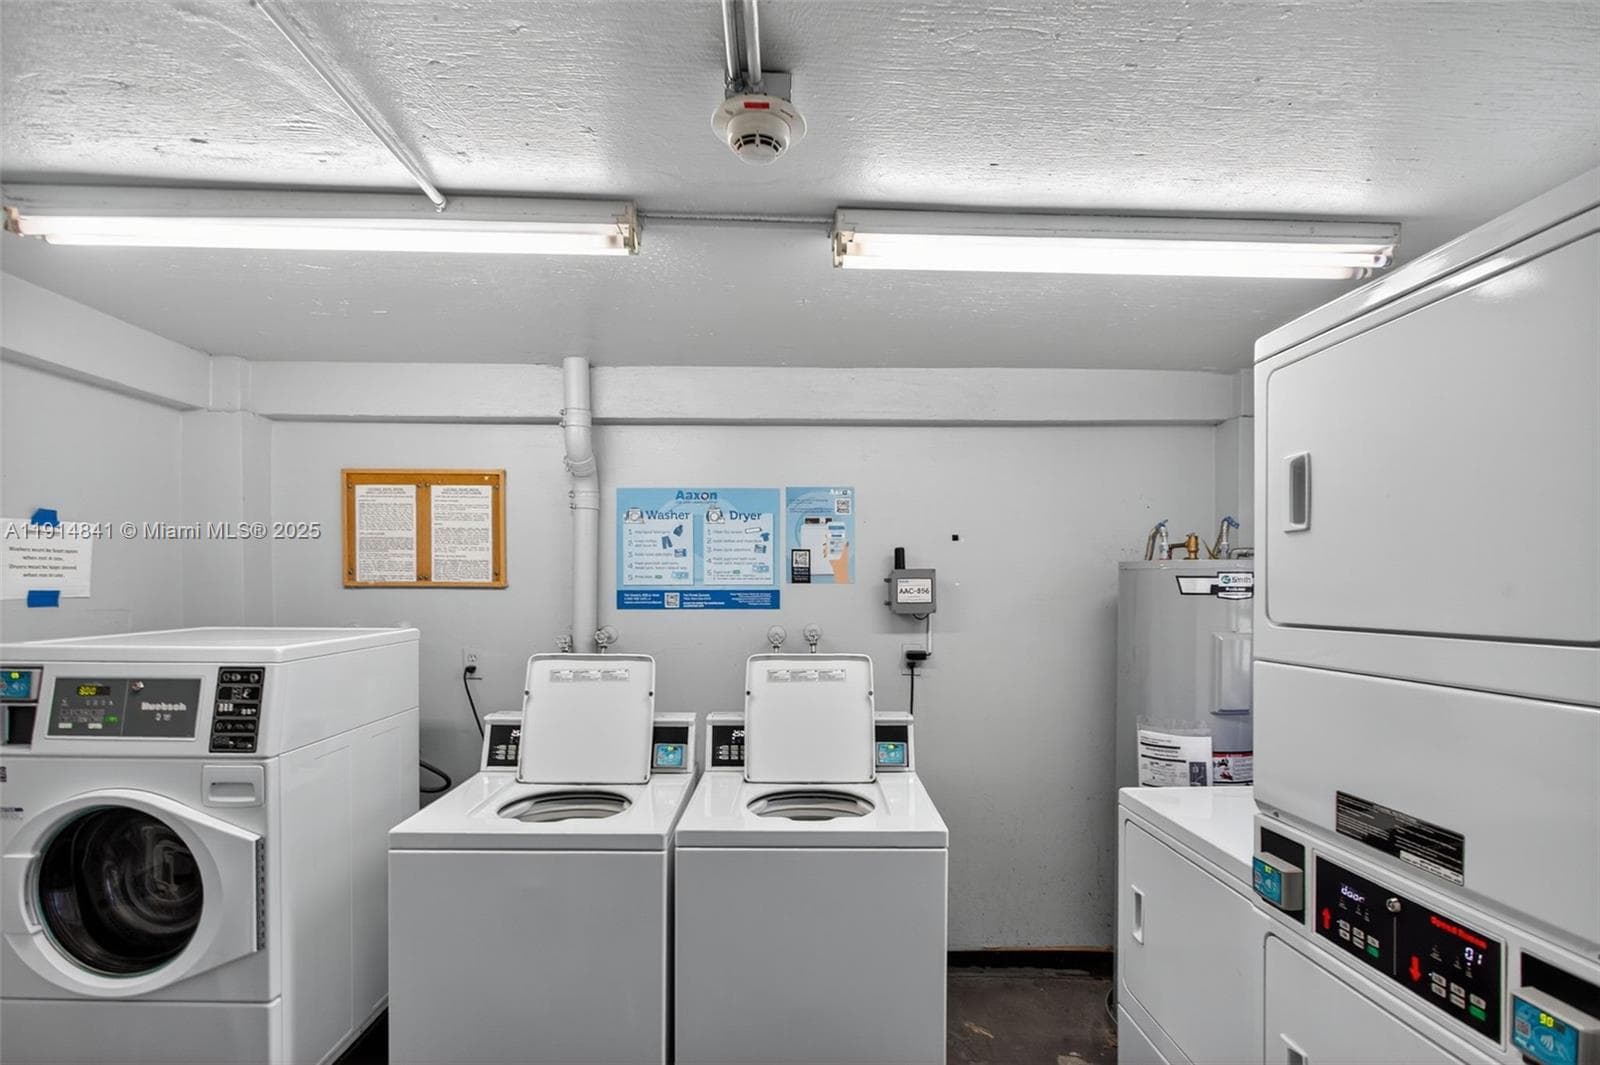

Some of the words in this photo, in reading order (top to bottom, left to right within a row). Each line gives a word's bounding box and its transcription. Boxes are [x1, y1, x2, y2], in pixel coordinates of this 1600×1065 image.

[675, 490, 718, 501] Aaxon
[645, 510, 691, 520] Washer
[729, 510, 763, 523] Dryer
[1340, 885, 1366, 904] door
